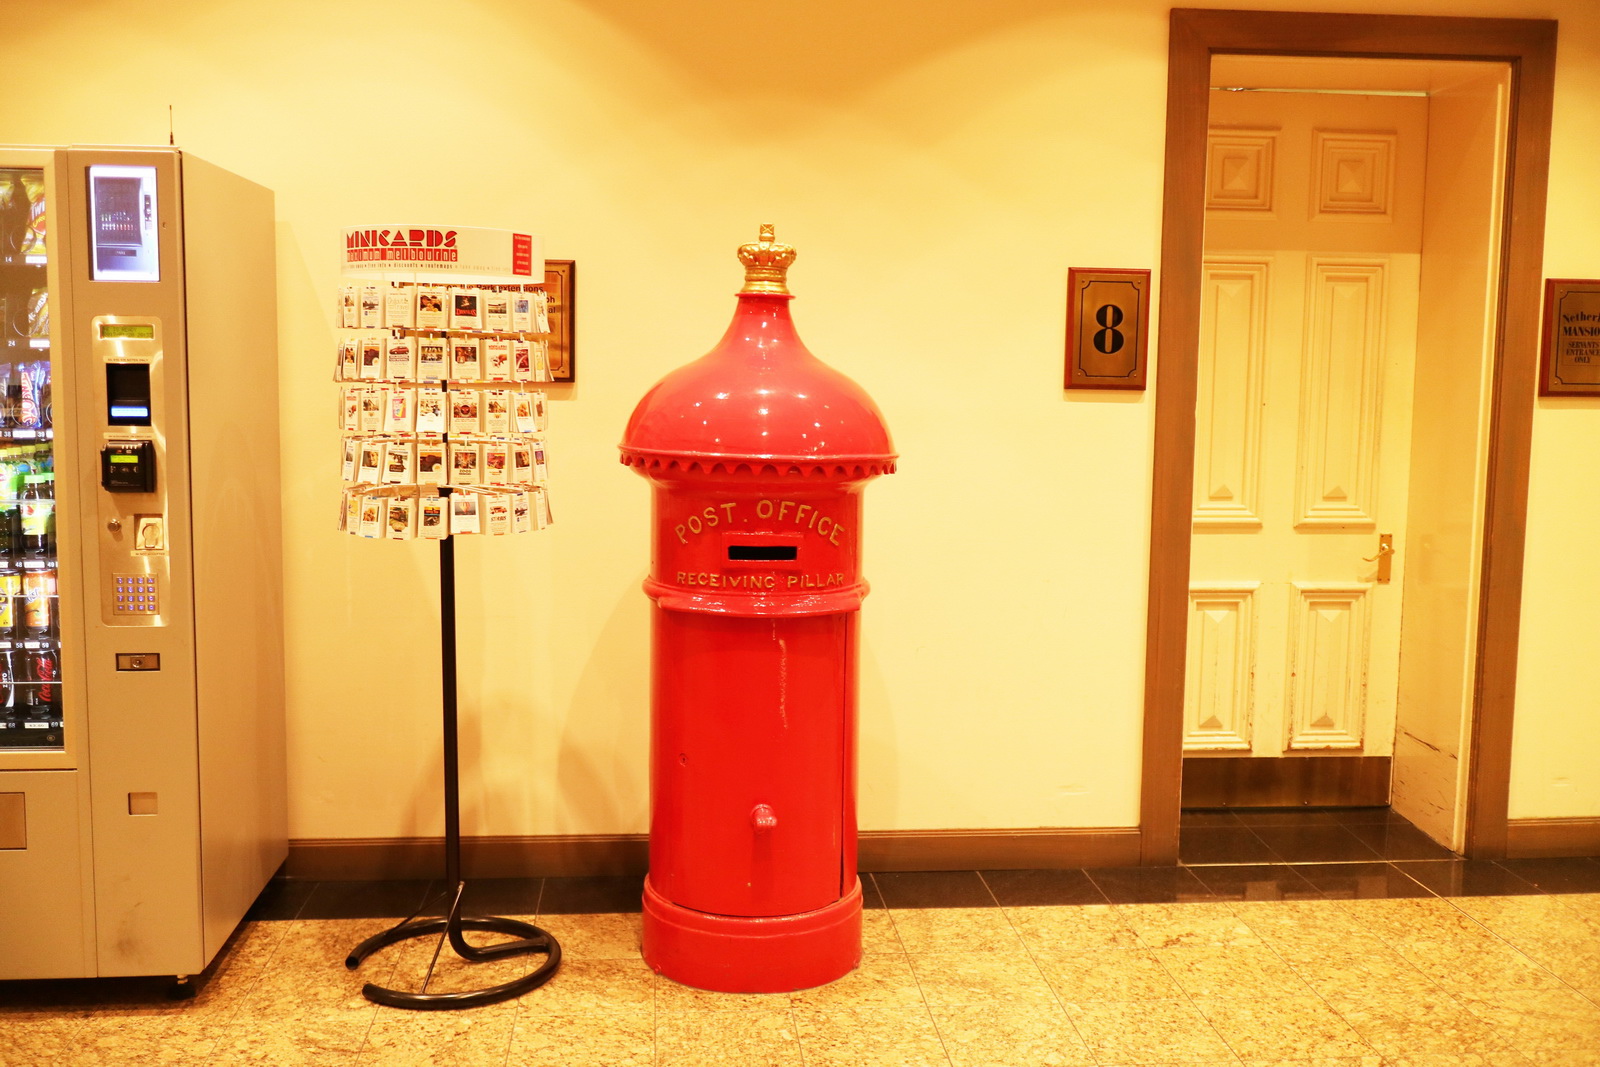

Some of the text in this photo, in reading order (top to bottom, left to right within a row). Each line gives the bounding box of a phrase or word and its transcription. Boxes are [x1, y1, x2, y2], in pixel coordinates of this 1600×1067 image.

[386, 249, 458, 262] melbourne
[1093, 304, 1124, 354] 8
[1574, 356, 1591, 364] ONLY
[675, 499, 845, 547] POST OFFICE
[677, 571, 845, 589] RECEIVING PILLAR
